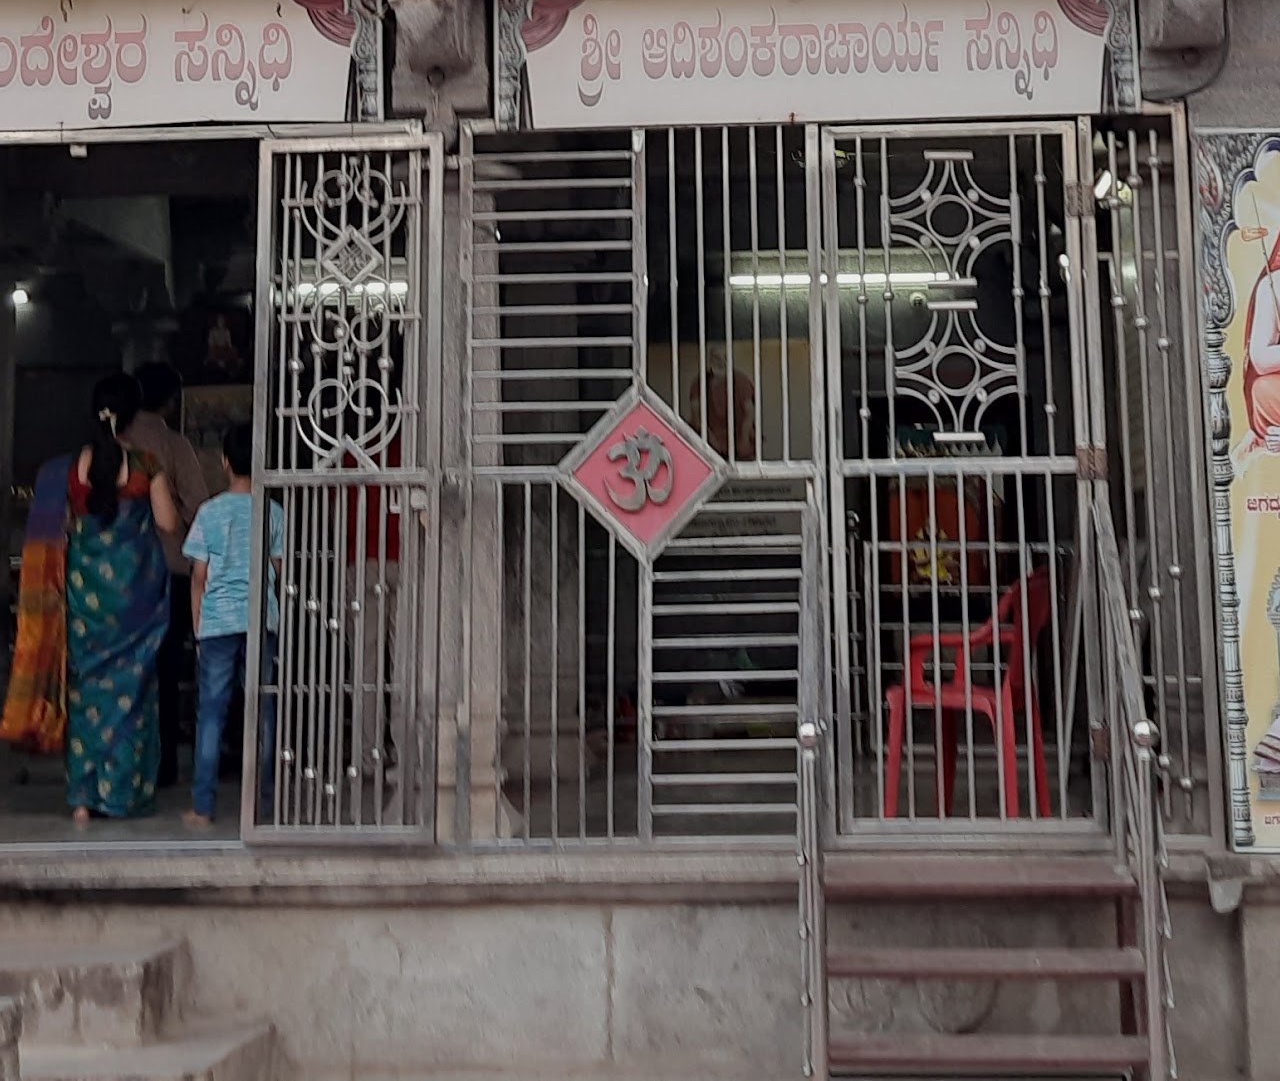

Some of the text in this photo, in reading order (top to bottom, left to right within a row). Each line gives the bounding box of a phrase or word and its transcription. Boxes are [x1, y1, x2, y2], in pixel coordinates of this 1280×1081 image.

[174, 11, 294, 111] ಸನ್ನಿಧಿ
[577, 13, 621, 107] ಶ್ರೀ
[965, 1, 1059, 100] ಸನ್ನಿಧಿ
